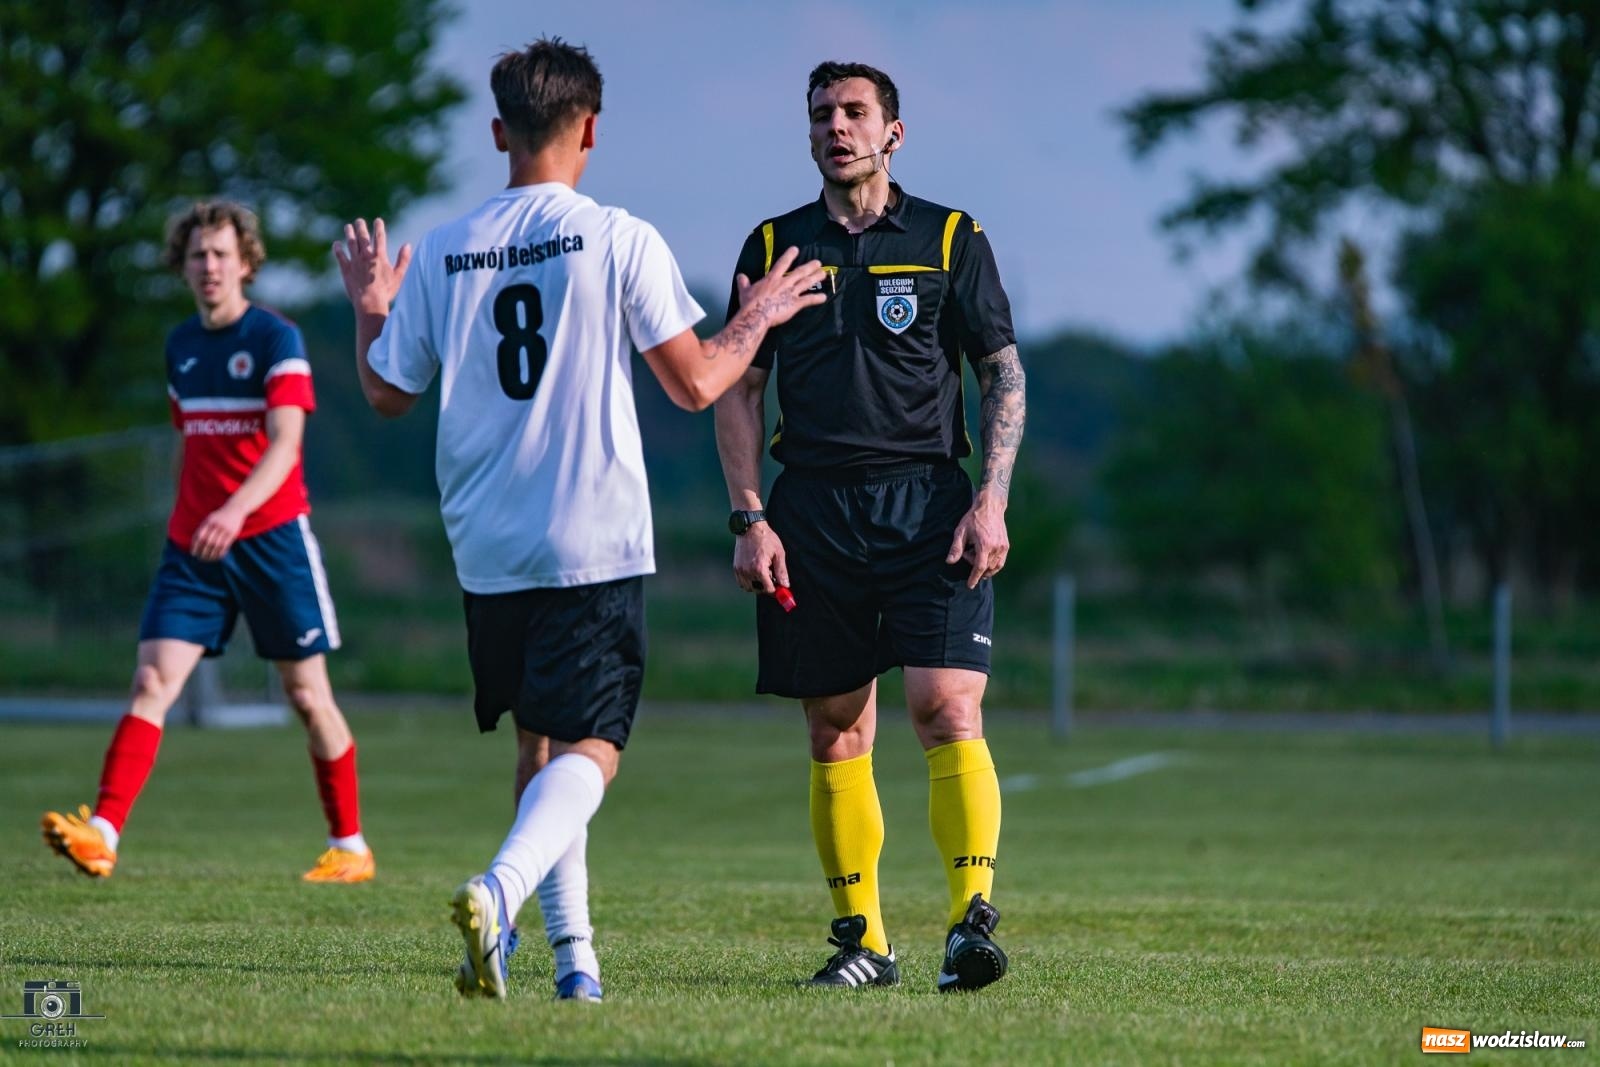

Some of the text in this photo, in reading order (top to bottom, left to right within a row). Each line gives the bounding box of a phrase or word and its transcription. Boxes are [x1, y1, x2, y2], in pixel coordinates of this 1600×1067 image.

[445, 246, 504, 276] Rozwój
[878, 278, 914, 288] KOLEGIUM
[493, 283, 548, 401] 8
